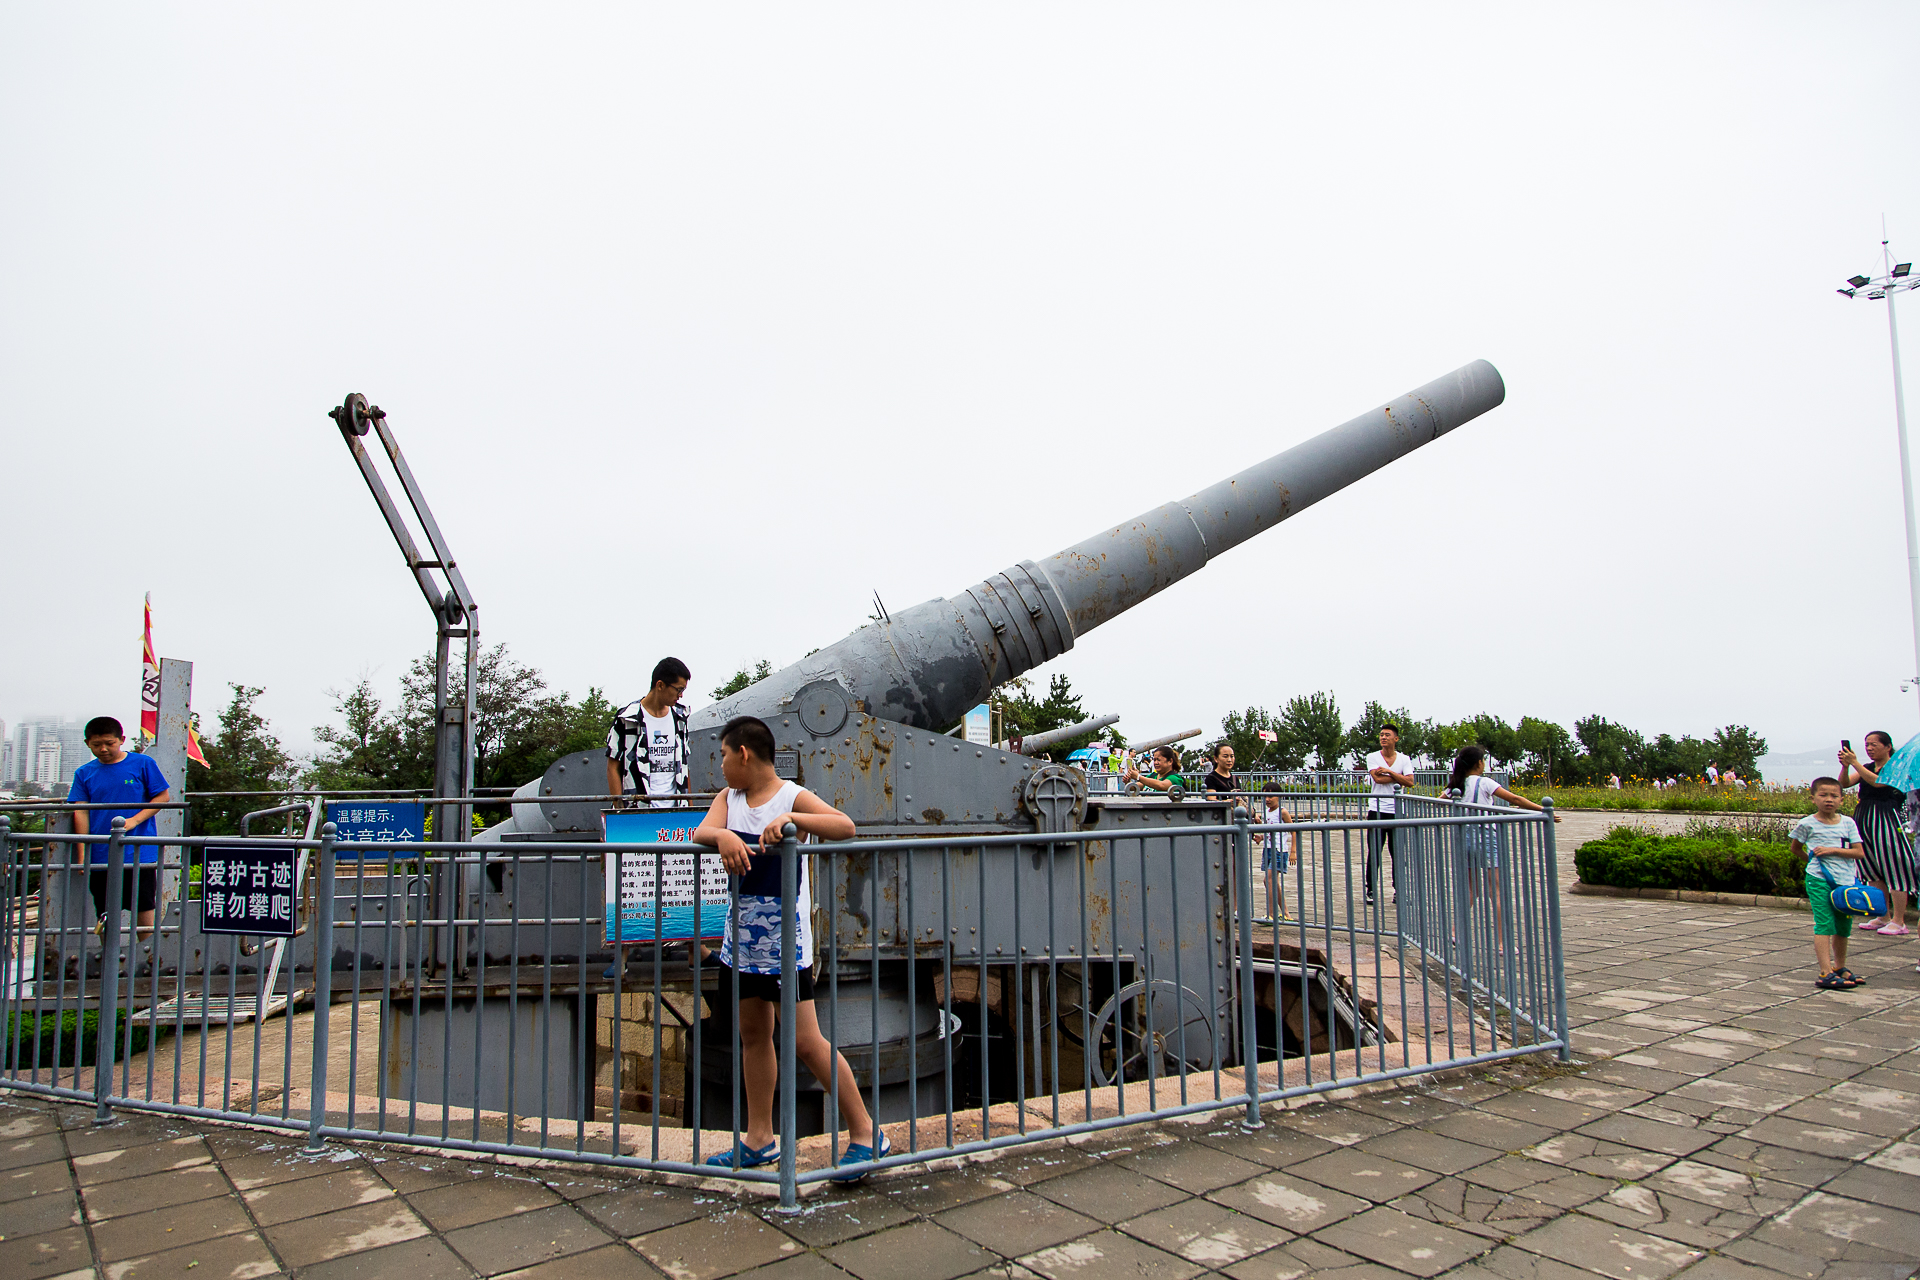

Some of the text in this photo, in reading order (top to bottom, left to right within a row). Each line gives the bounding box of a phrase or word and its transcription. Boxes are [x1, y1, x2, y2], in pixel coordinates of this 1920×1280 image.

[207, 860, 291, 888] 爱护古迹
[206, 891, 291, 921] 请勿攀爬
